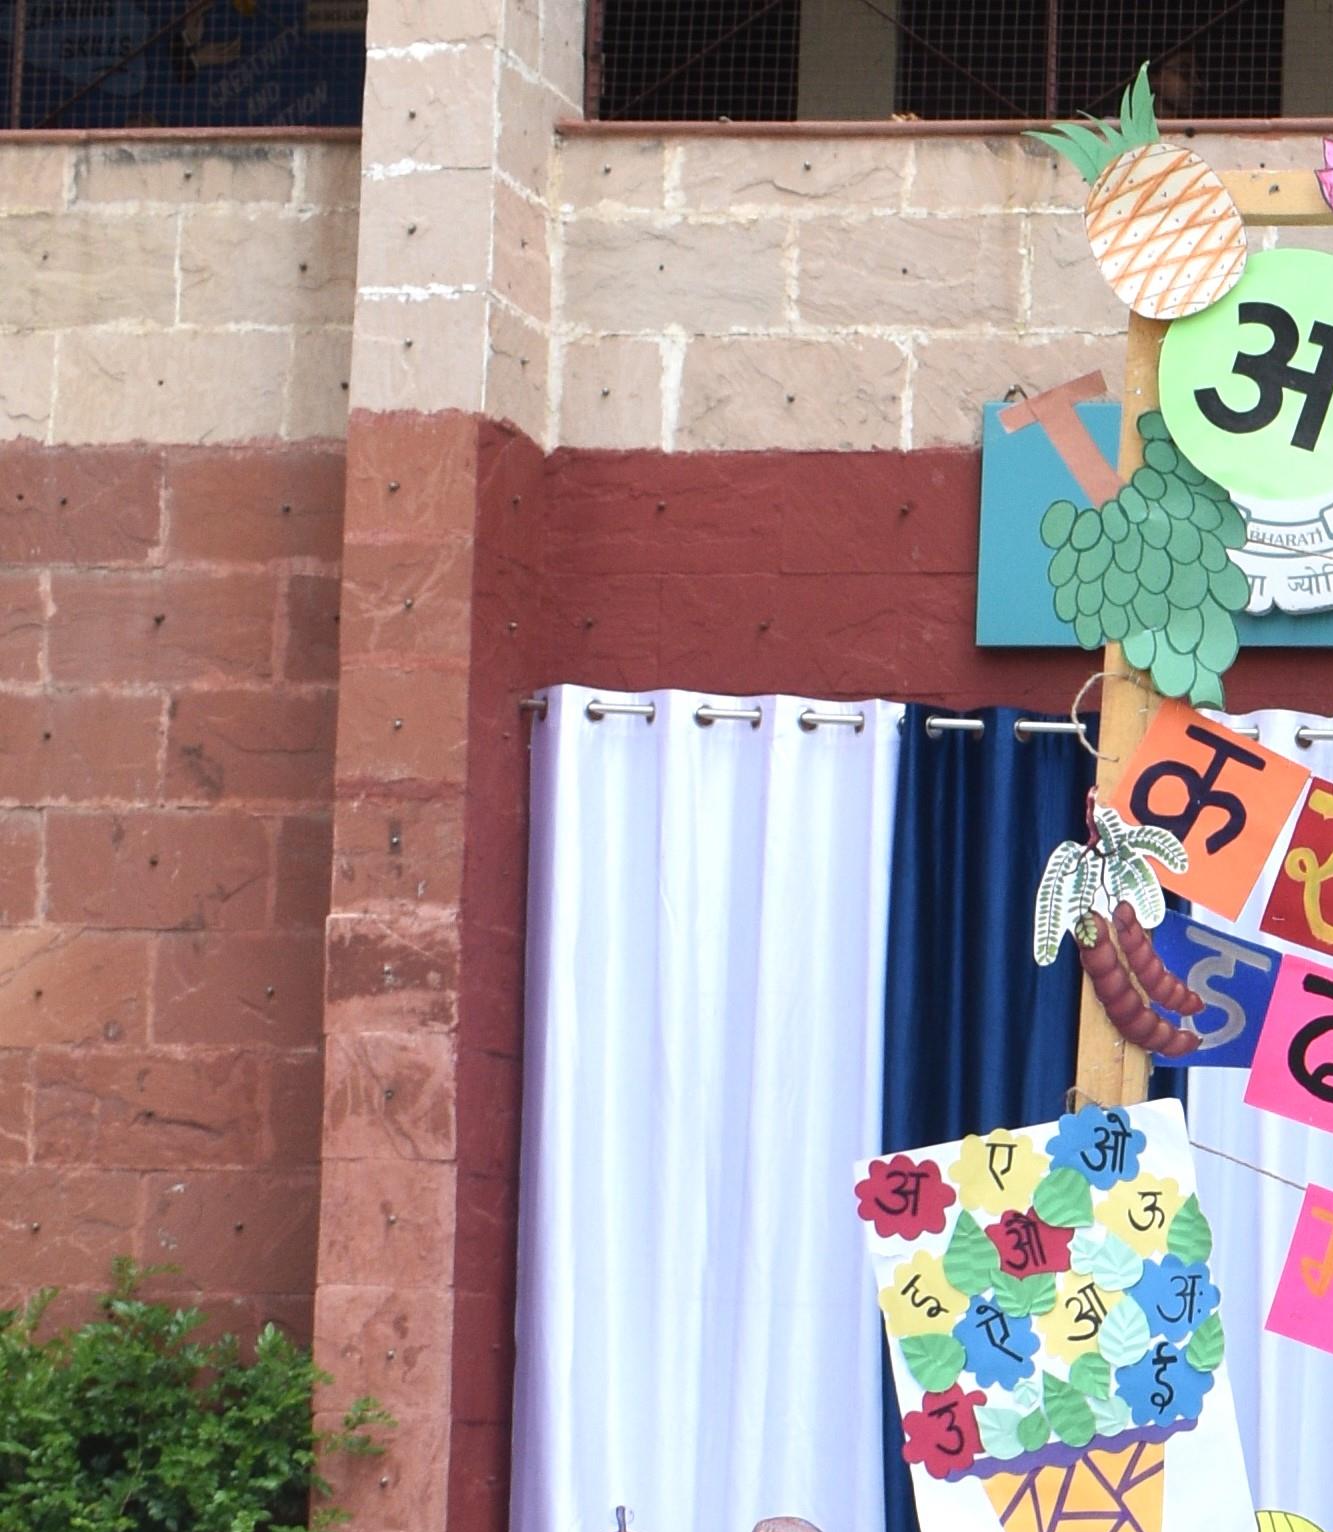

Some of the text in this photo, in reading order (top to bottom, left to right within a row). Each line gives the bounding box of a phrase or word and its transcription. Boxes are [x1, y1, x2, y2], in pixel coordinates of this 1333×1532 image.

[1129, 723, 1266, 856] क
[985, 1142, 1018, 1191] ए
[874, 1170, 930, 1217] अ
